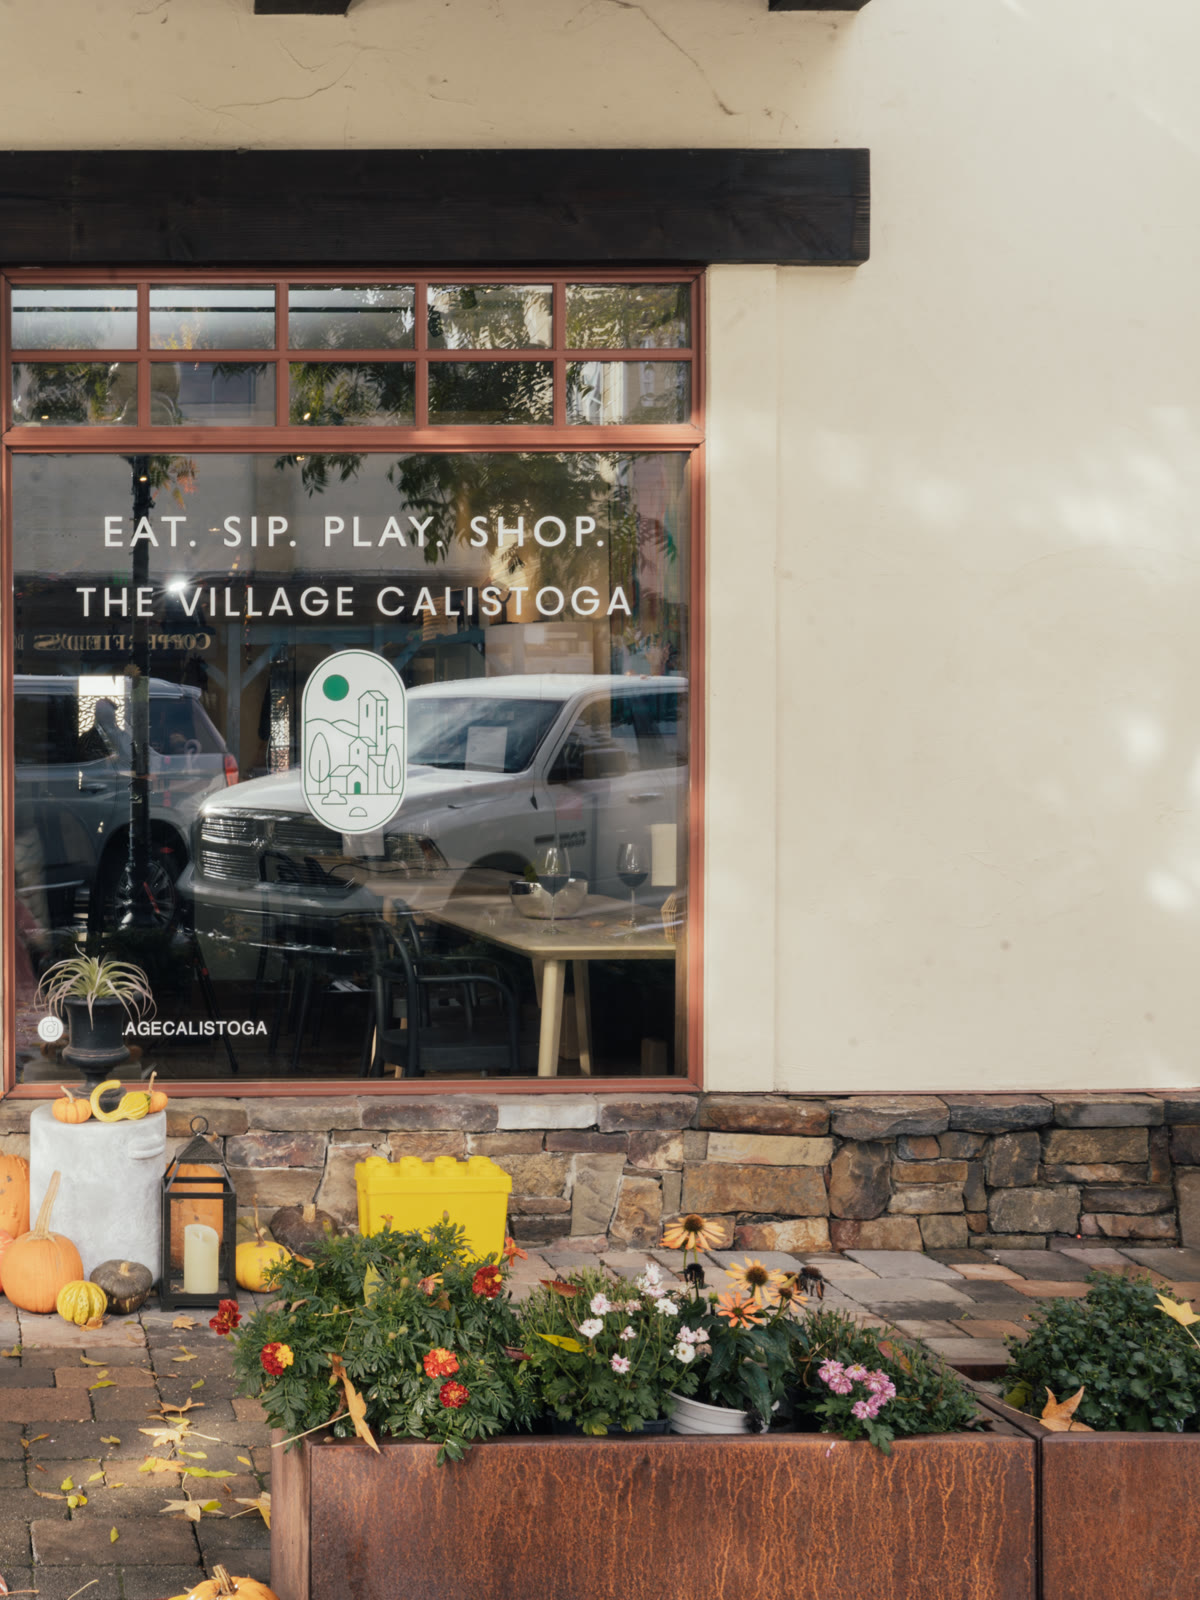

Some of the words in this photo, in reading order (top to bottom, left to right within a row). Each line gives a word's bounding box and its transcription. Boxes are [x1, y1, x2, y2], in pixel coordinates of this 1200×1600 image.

[103, 515, 196, 548] EAT.
[222, 515, 296, 548] SIP.
[323, 515, 443, 548] PLAY.
[469, 515, 604, 548] SHOP.
[76, 586, 154, 617] THE
[179, 585, 354, 617] VILLAGE
[376, 585, 631, 617] CALISTOGA
[121, 1020, 268, 1036] AGECALISTOGA
